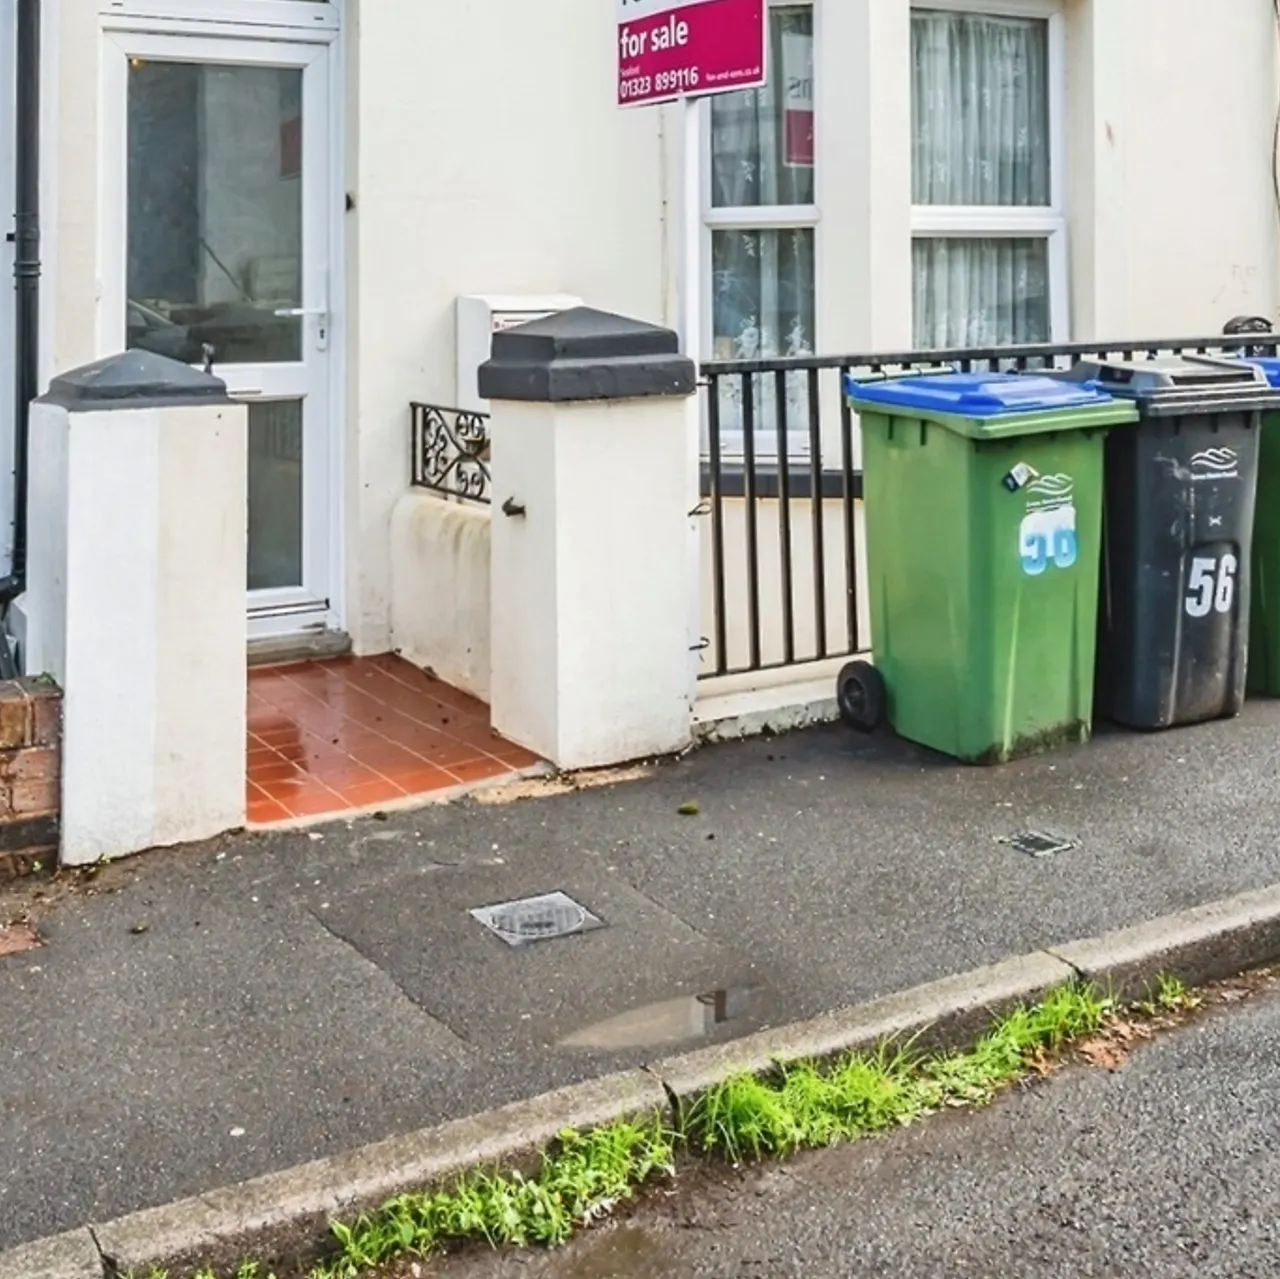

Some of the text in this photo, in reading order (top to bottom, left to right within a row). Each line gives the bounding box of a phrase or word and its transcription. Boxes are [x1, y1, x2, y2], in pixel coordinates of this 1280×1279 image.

[620, 15, 689, 59] for sale
[621, 66, 699, 98] 01323 899116
[1185, 553, 1238, 617] 56
